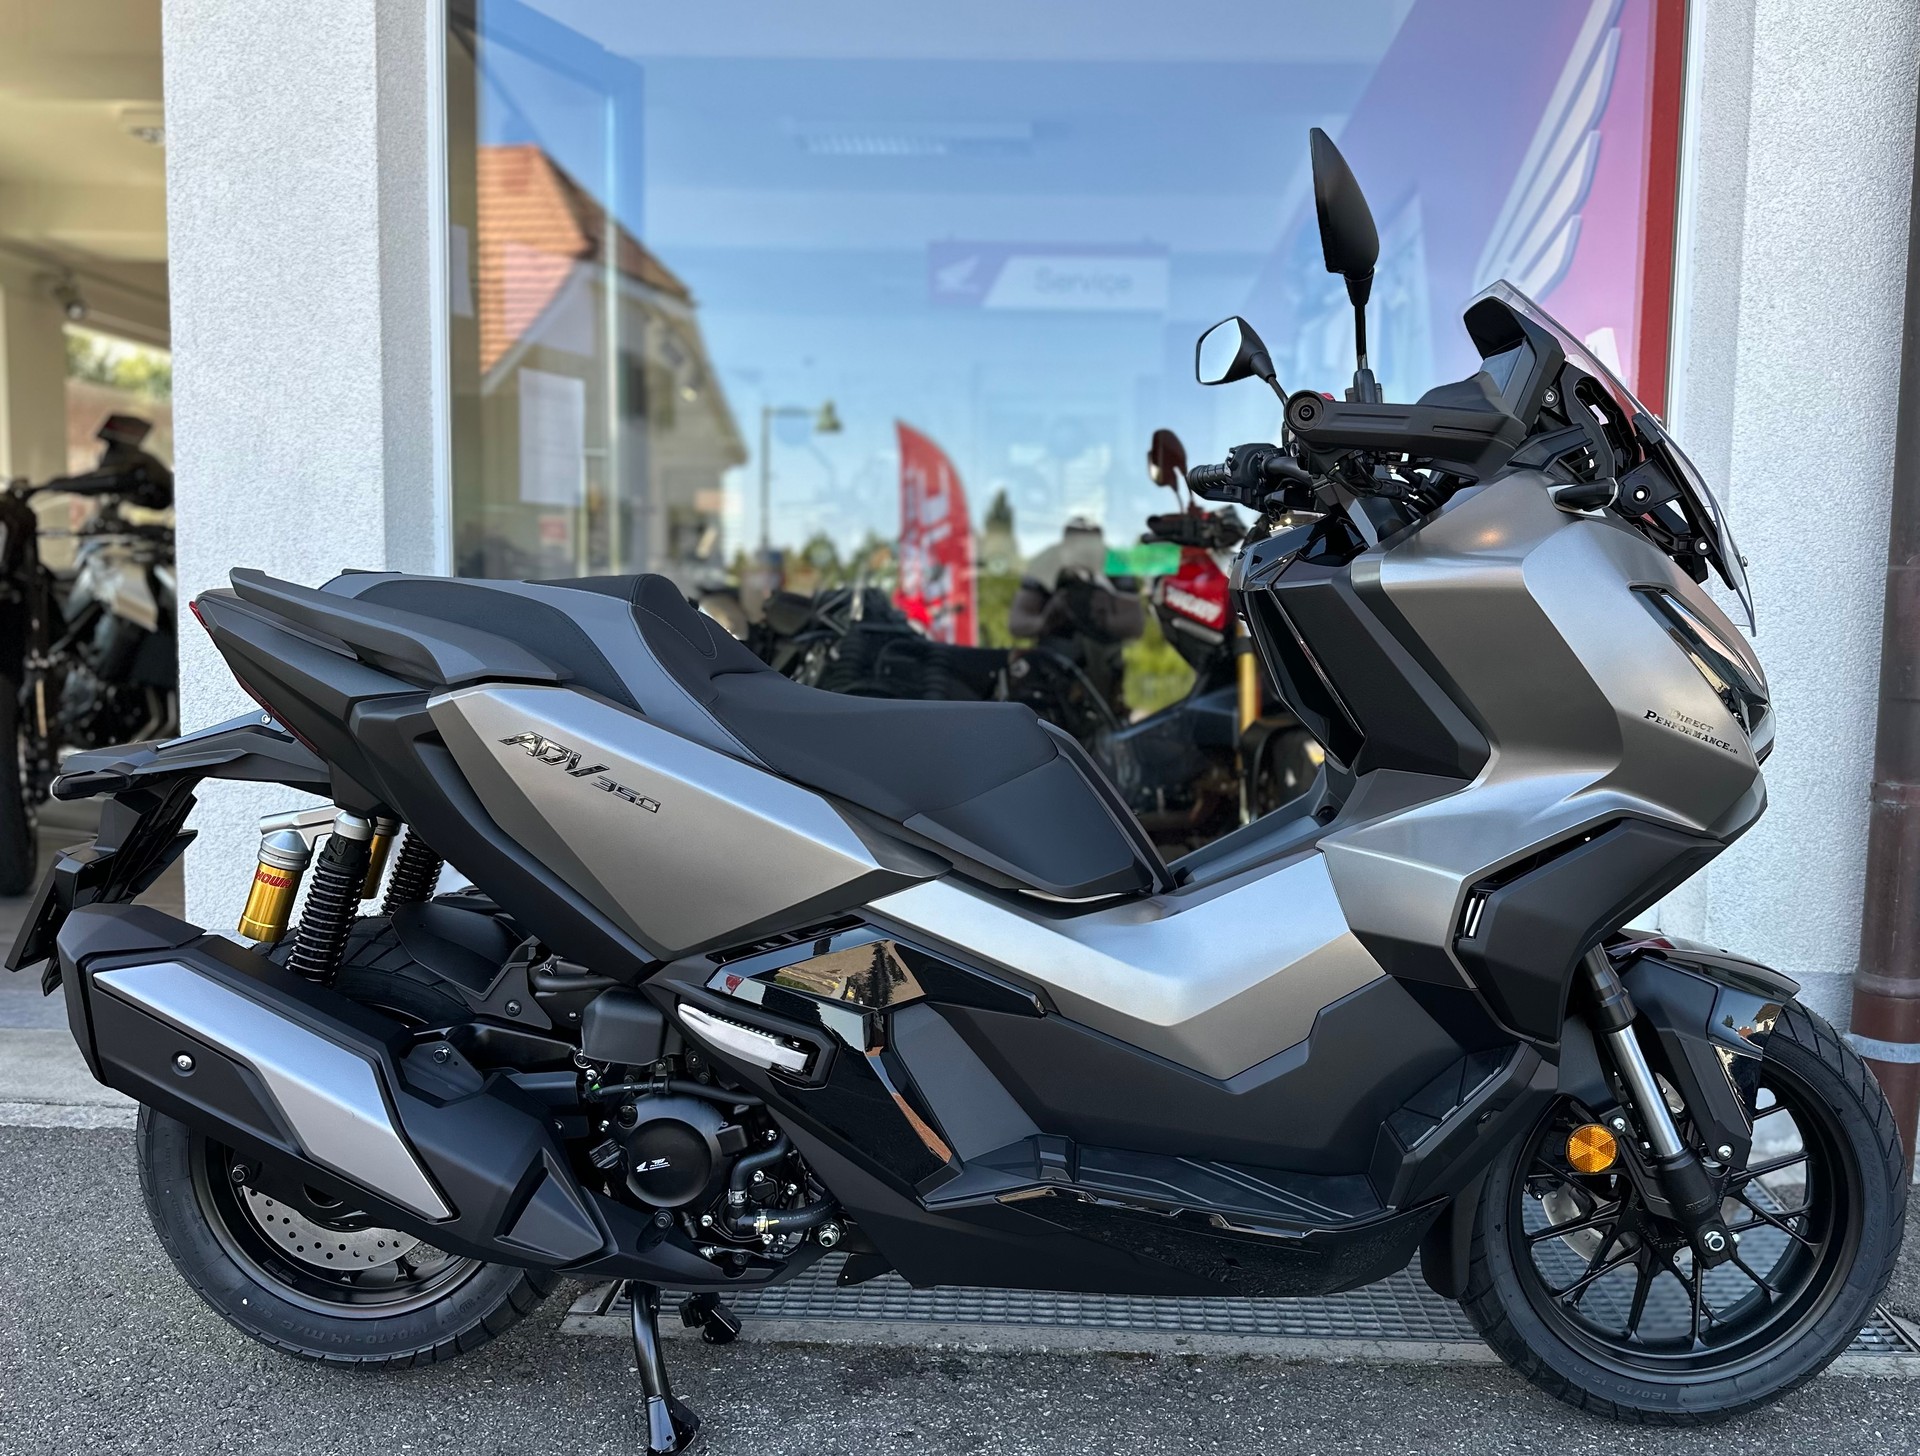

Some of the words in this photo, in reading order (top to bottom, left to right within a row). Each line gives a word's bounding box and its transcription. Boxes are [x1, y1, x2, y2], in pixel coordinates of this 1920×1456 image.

[1033, 266, 1134, 297] Service
[1669, 707, 1714, 733] DIRECT
[498, 731, 610, 777] ADV
[590, 775, 662, 814] 350
[255, 869, 293, 889] HOWA
